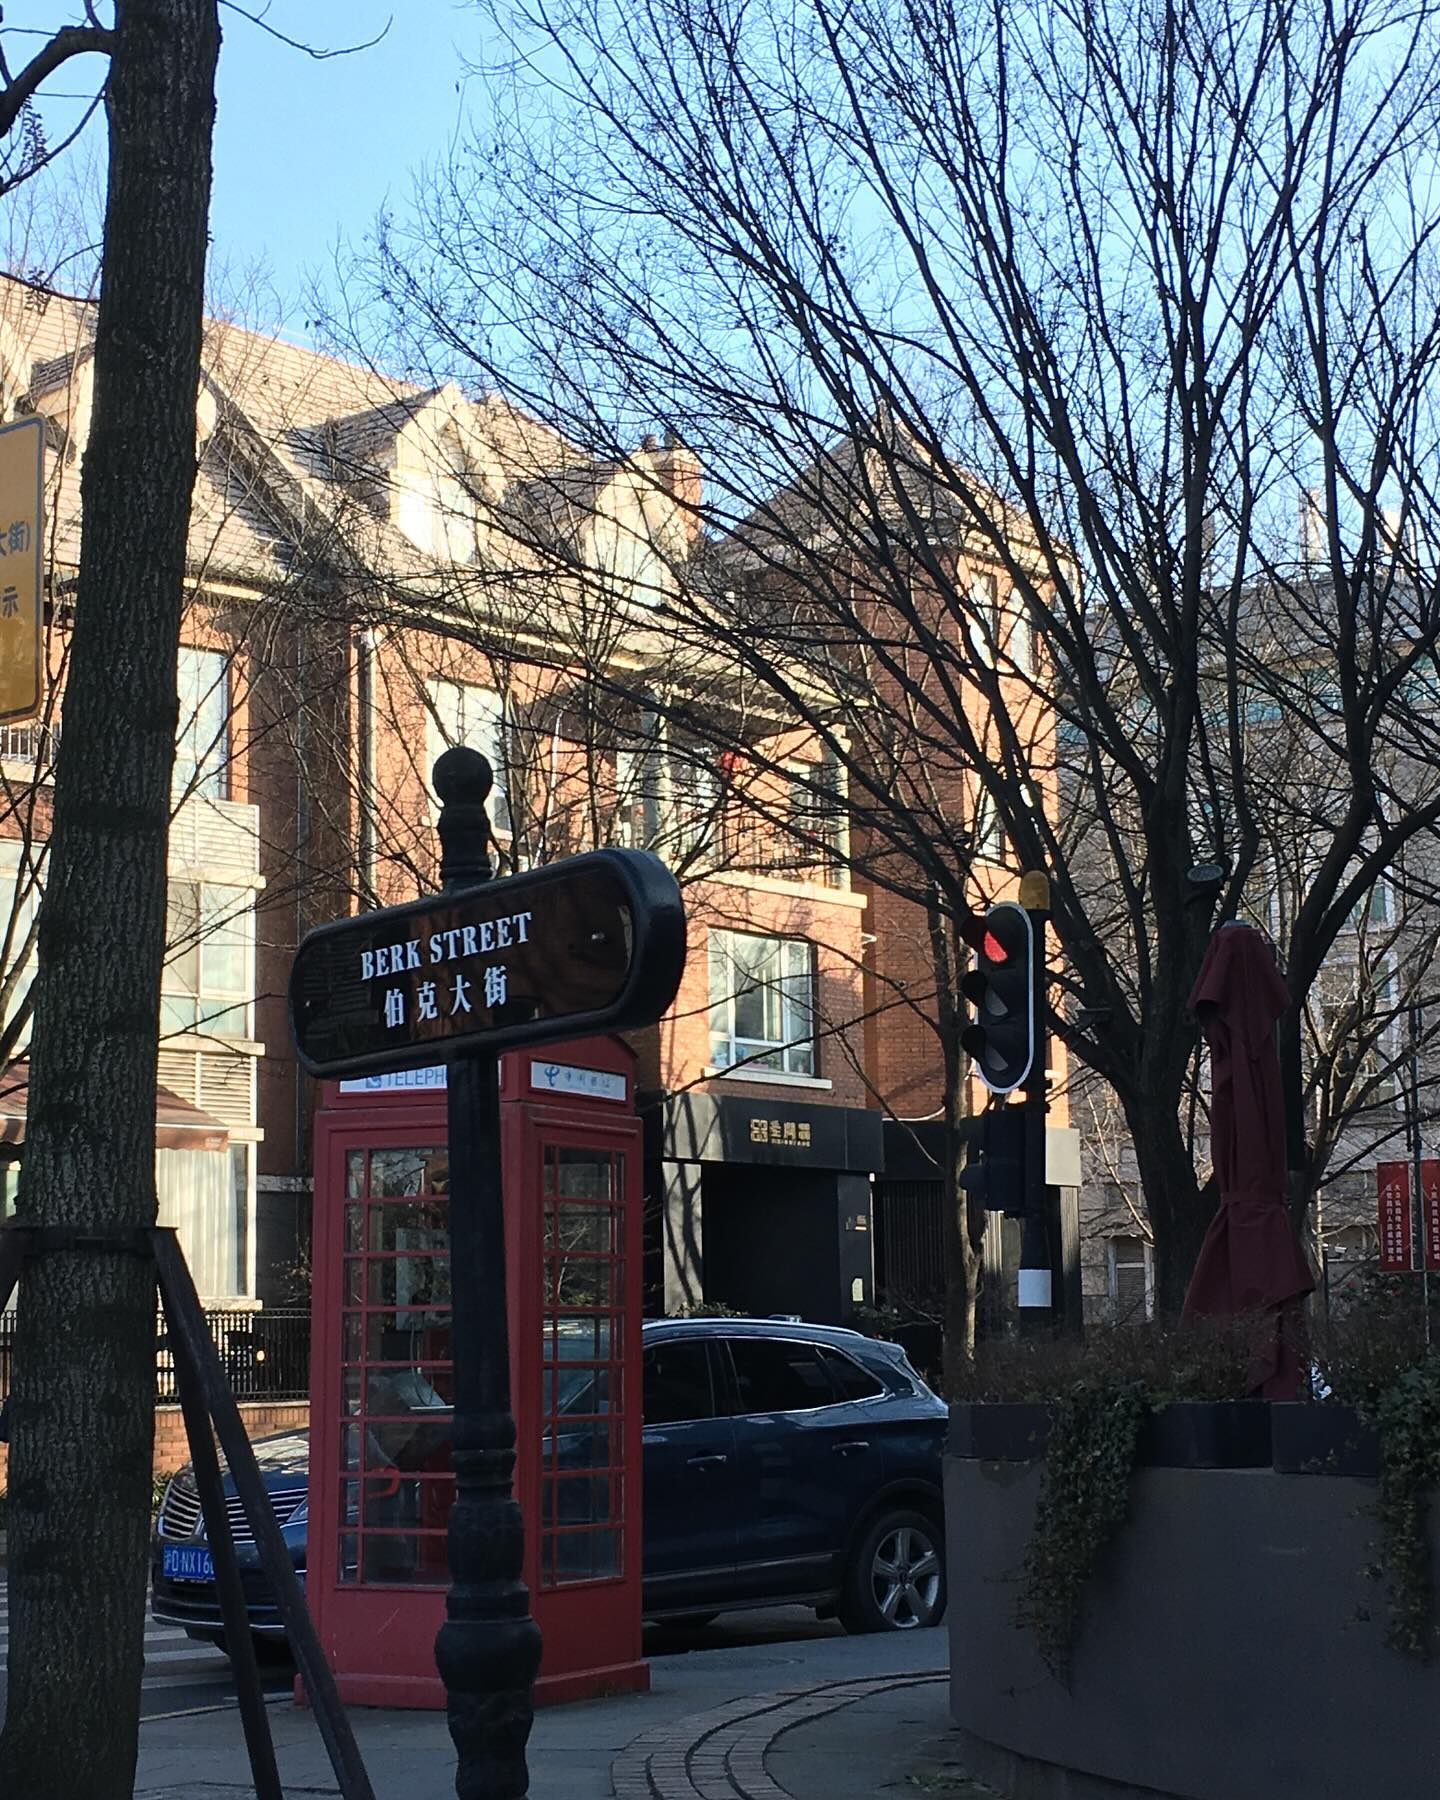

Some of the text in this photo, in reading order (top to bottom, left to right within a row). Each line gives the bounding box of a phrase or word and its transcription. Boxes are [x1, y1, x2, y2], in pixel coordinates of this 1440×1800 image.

[361, 911, 532, 981] BERK STREET
[384, 965, 508, 1029] 伯克大街
